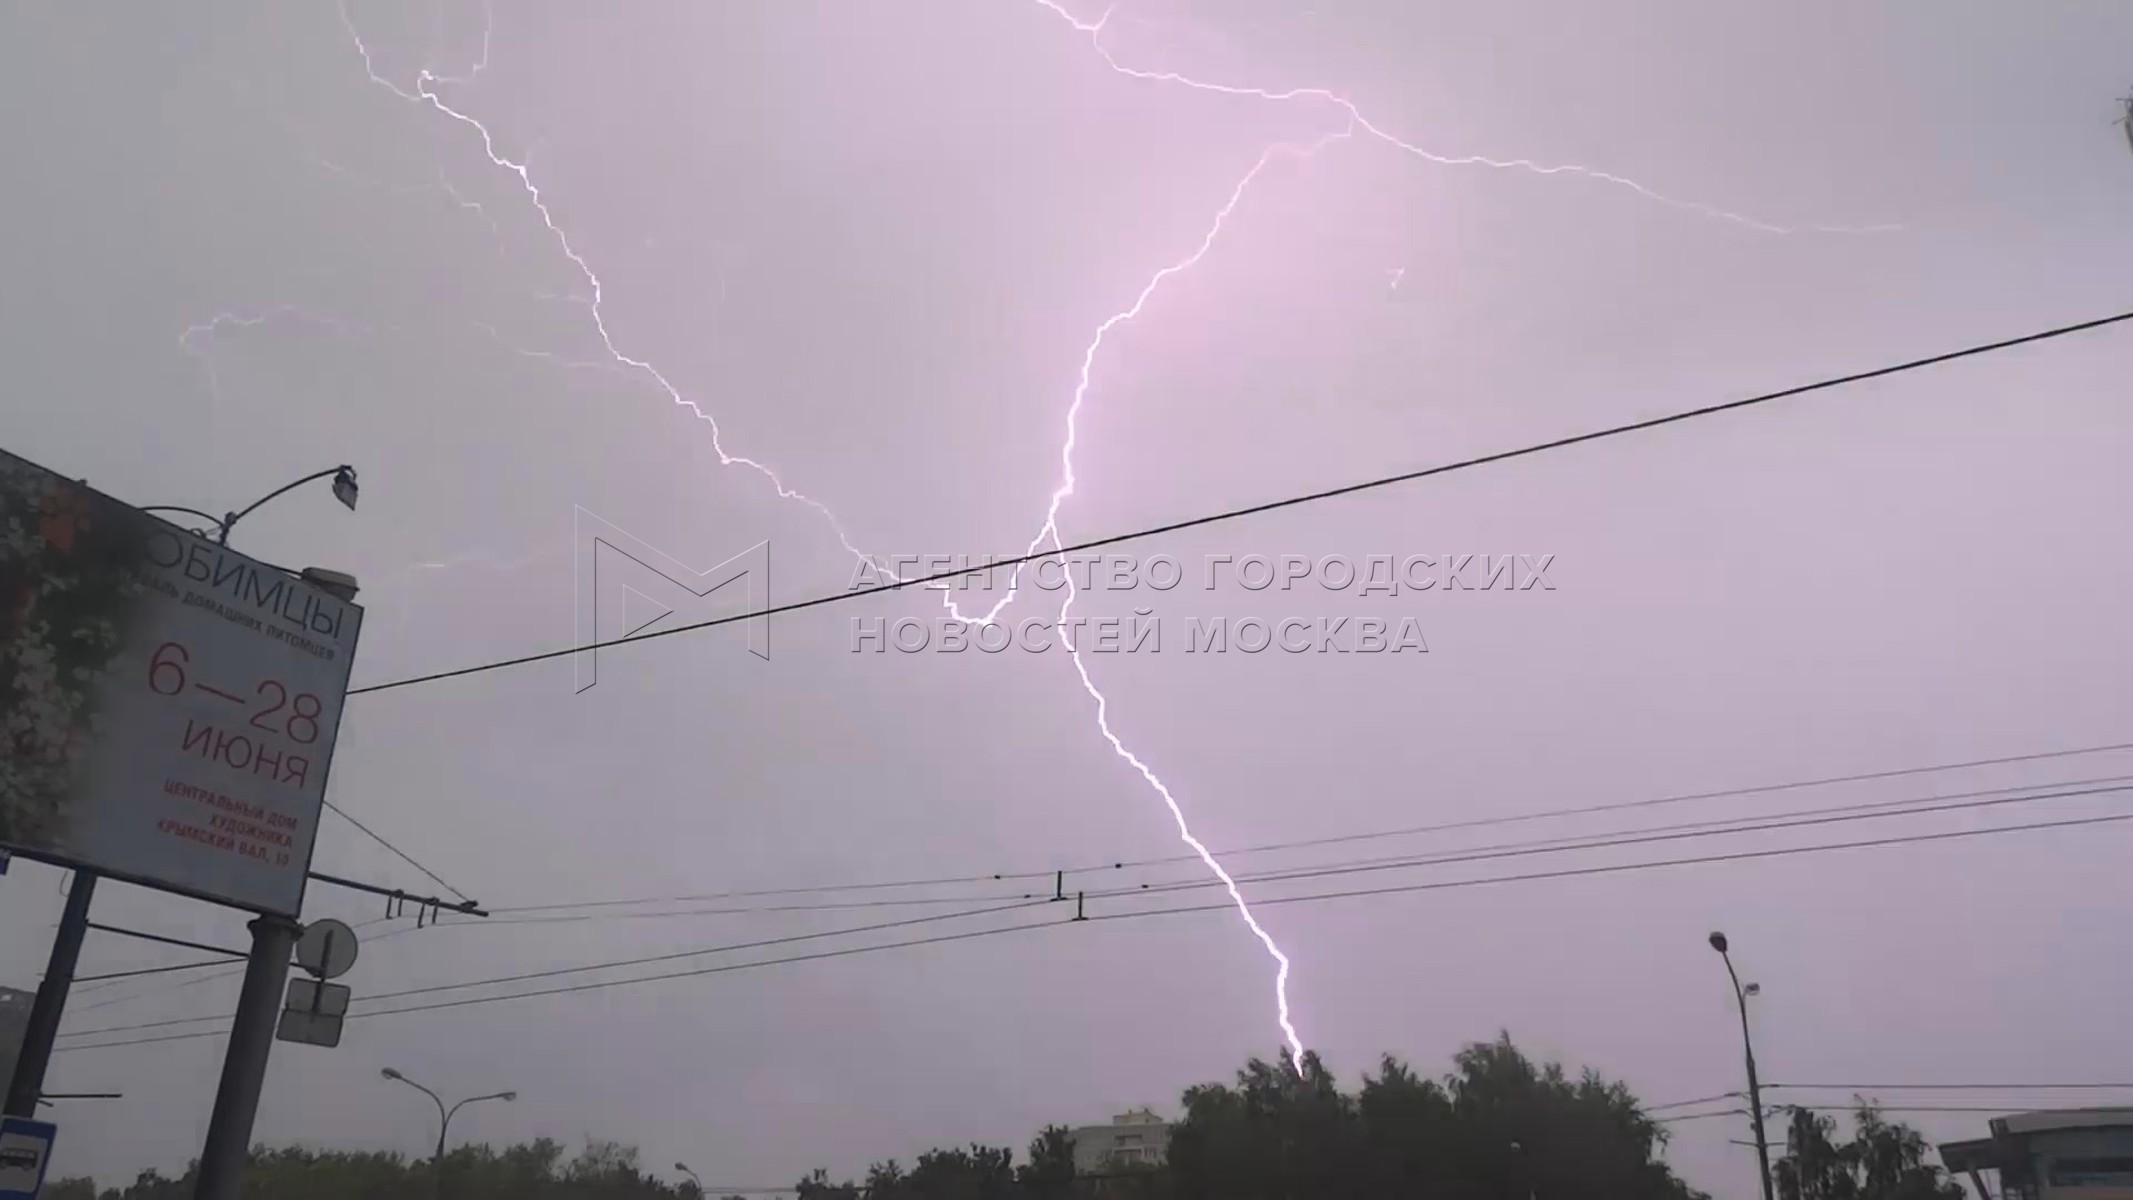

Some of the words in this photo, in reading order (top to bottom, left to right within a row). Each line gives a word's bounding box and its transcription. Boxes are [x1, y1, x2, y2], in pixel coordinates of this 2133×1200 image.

[182, 591, 262, 632] ДОМАШНИХ
[266, 624, 336, 661] ПИТОМЦЕВ
[182, 719, 309, 789] ИЮНЯ
[164, 778, 265, 820] ЦЕНТРАЛЬНЫЙ
[267, 811, 298, 831] ДОМ
[210, 814, 293, 848] ХУДОЖНИКА
[158, 818, 235, 850] КРЫМСКИЙ
[275, 852, 290, 867] 10
